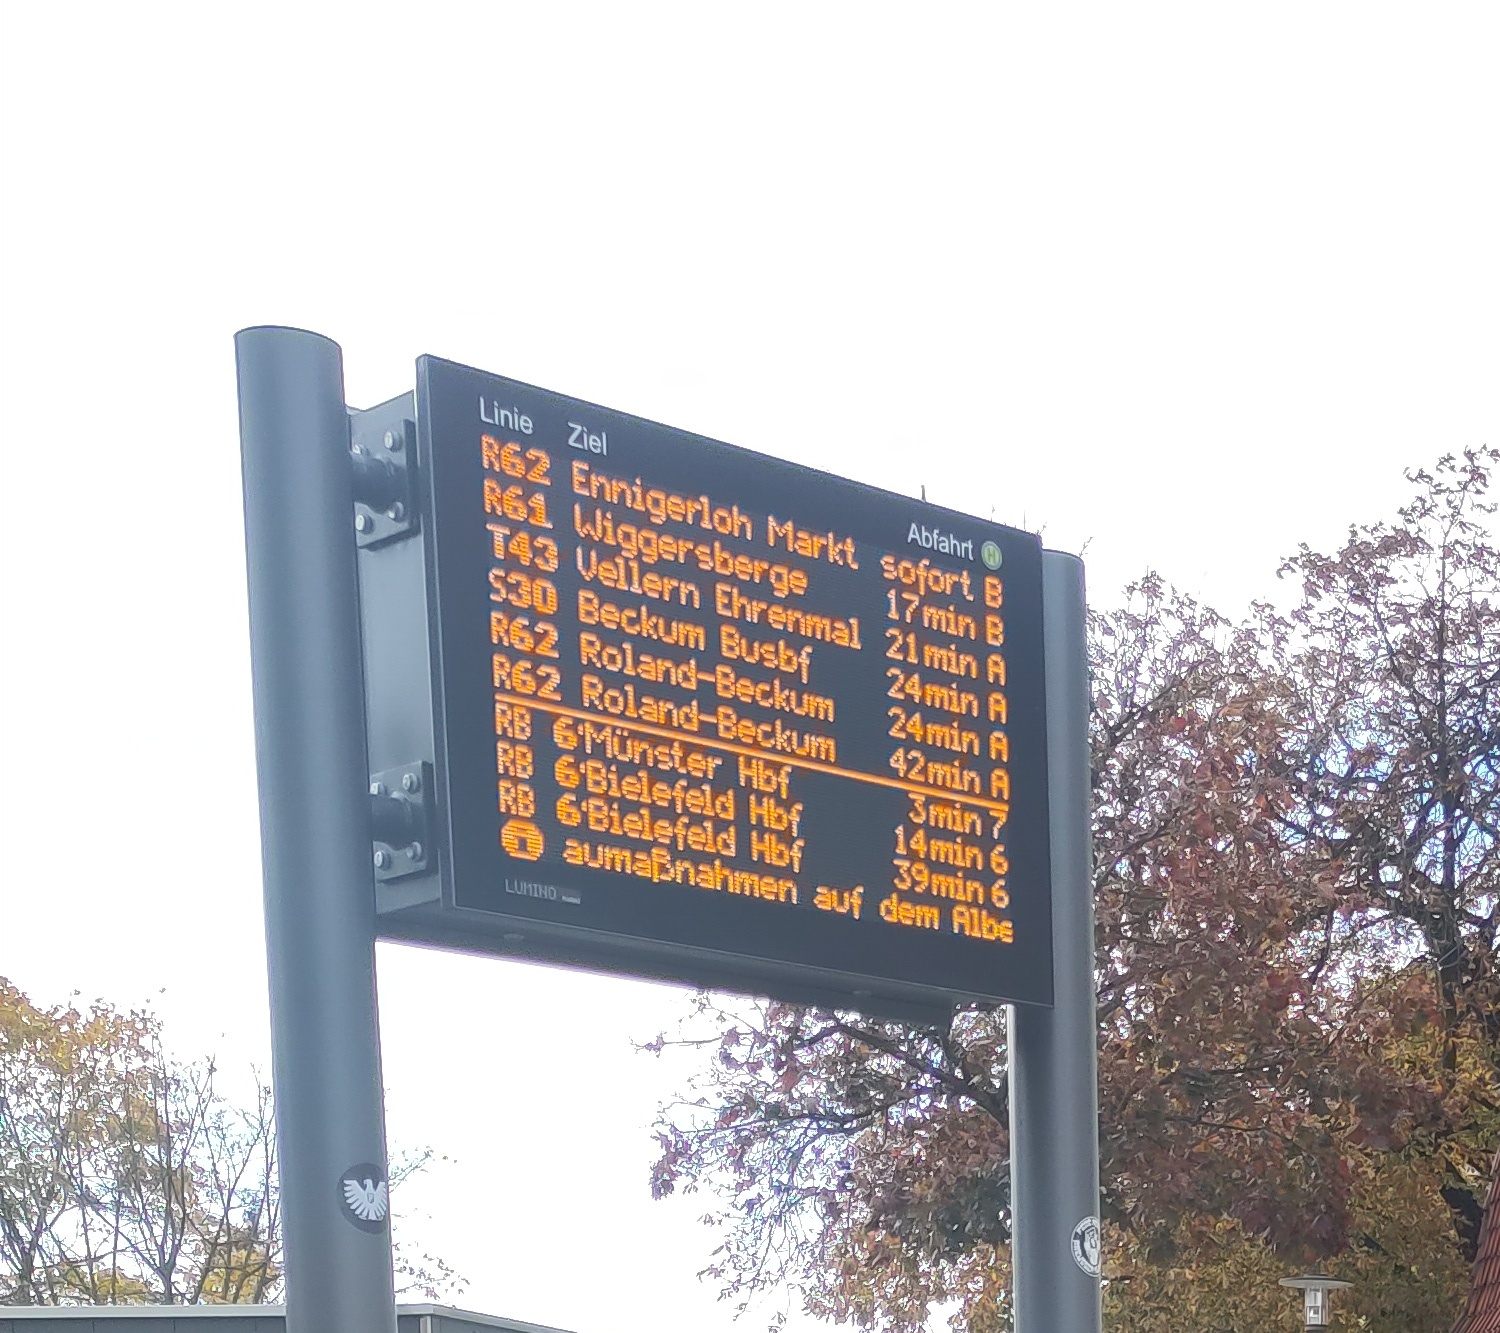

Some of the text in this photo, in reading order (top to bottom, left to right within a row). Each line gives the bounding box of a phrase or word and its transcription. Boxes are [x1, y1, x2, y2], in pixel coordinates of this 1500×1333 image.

[479, 396, 608, 456] Linie Ziel
[481, 433, 1004, 609] R62 Ennigerloh Markt sofort B
[483, 477, 553, 529] R61
[573, 501, 809, 599] Wiggersberge
[985, 612, 1005, 647] B
[907, 522, 974, 561] Abfahrt
[486, 522, 559, 573] T43
[576, 545, 700, 610] Vellern
[715, 581, 862, 650] Ehrenmal
[986, 652, 1007, 687] A
[488, 567, 559, 616] S30
[577, 588, 706, 651] Beckum
[719, 624, 814, 684] Busbf
[987, 691, 1008, 724] A
[491, 610, 560, 658] R62
[579, 631, 836, 722] Roland-Beckum
[988, 730, 1009, 763] A
[492, 653, 562, 701] R62
[581, 673, 837, 763] Roland-Beckum
[990, 767, 1011, 801] A
[494, 702, 532, 741] RB
[737, 755, 793, 800] Hbf
[989, 808, 1008, 840] 7
[496, 740, 534, 780] RB
[749, 793, 804, 838] Hbf
[990, 843, 1010, 876] 6
[498, 778, 535, 818] RB
[751, 829, 806, 874] Hbf
[990, 878, 1010, 909] 6
[504, 878, 558, 901] LUMINO
[813, 884, 865, 921] auf
[879, 891, 941, 931] dem
